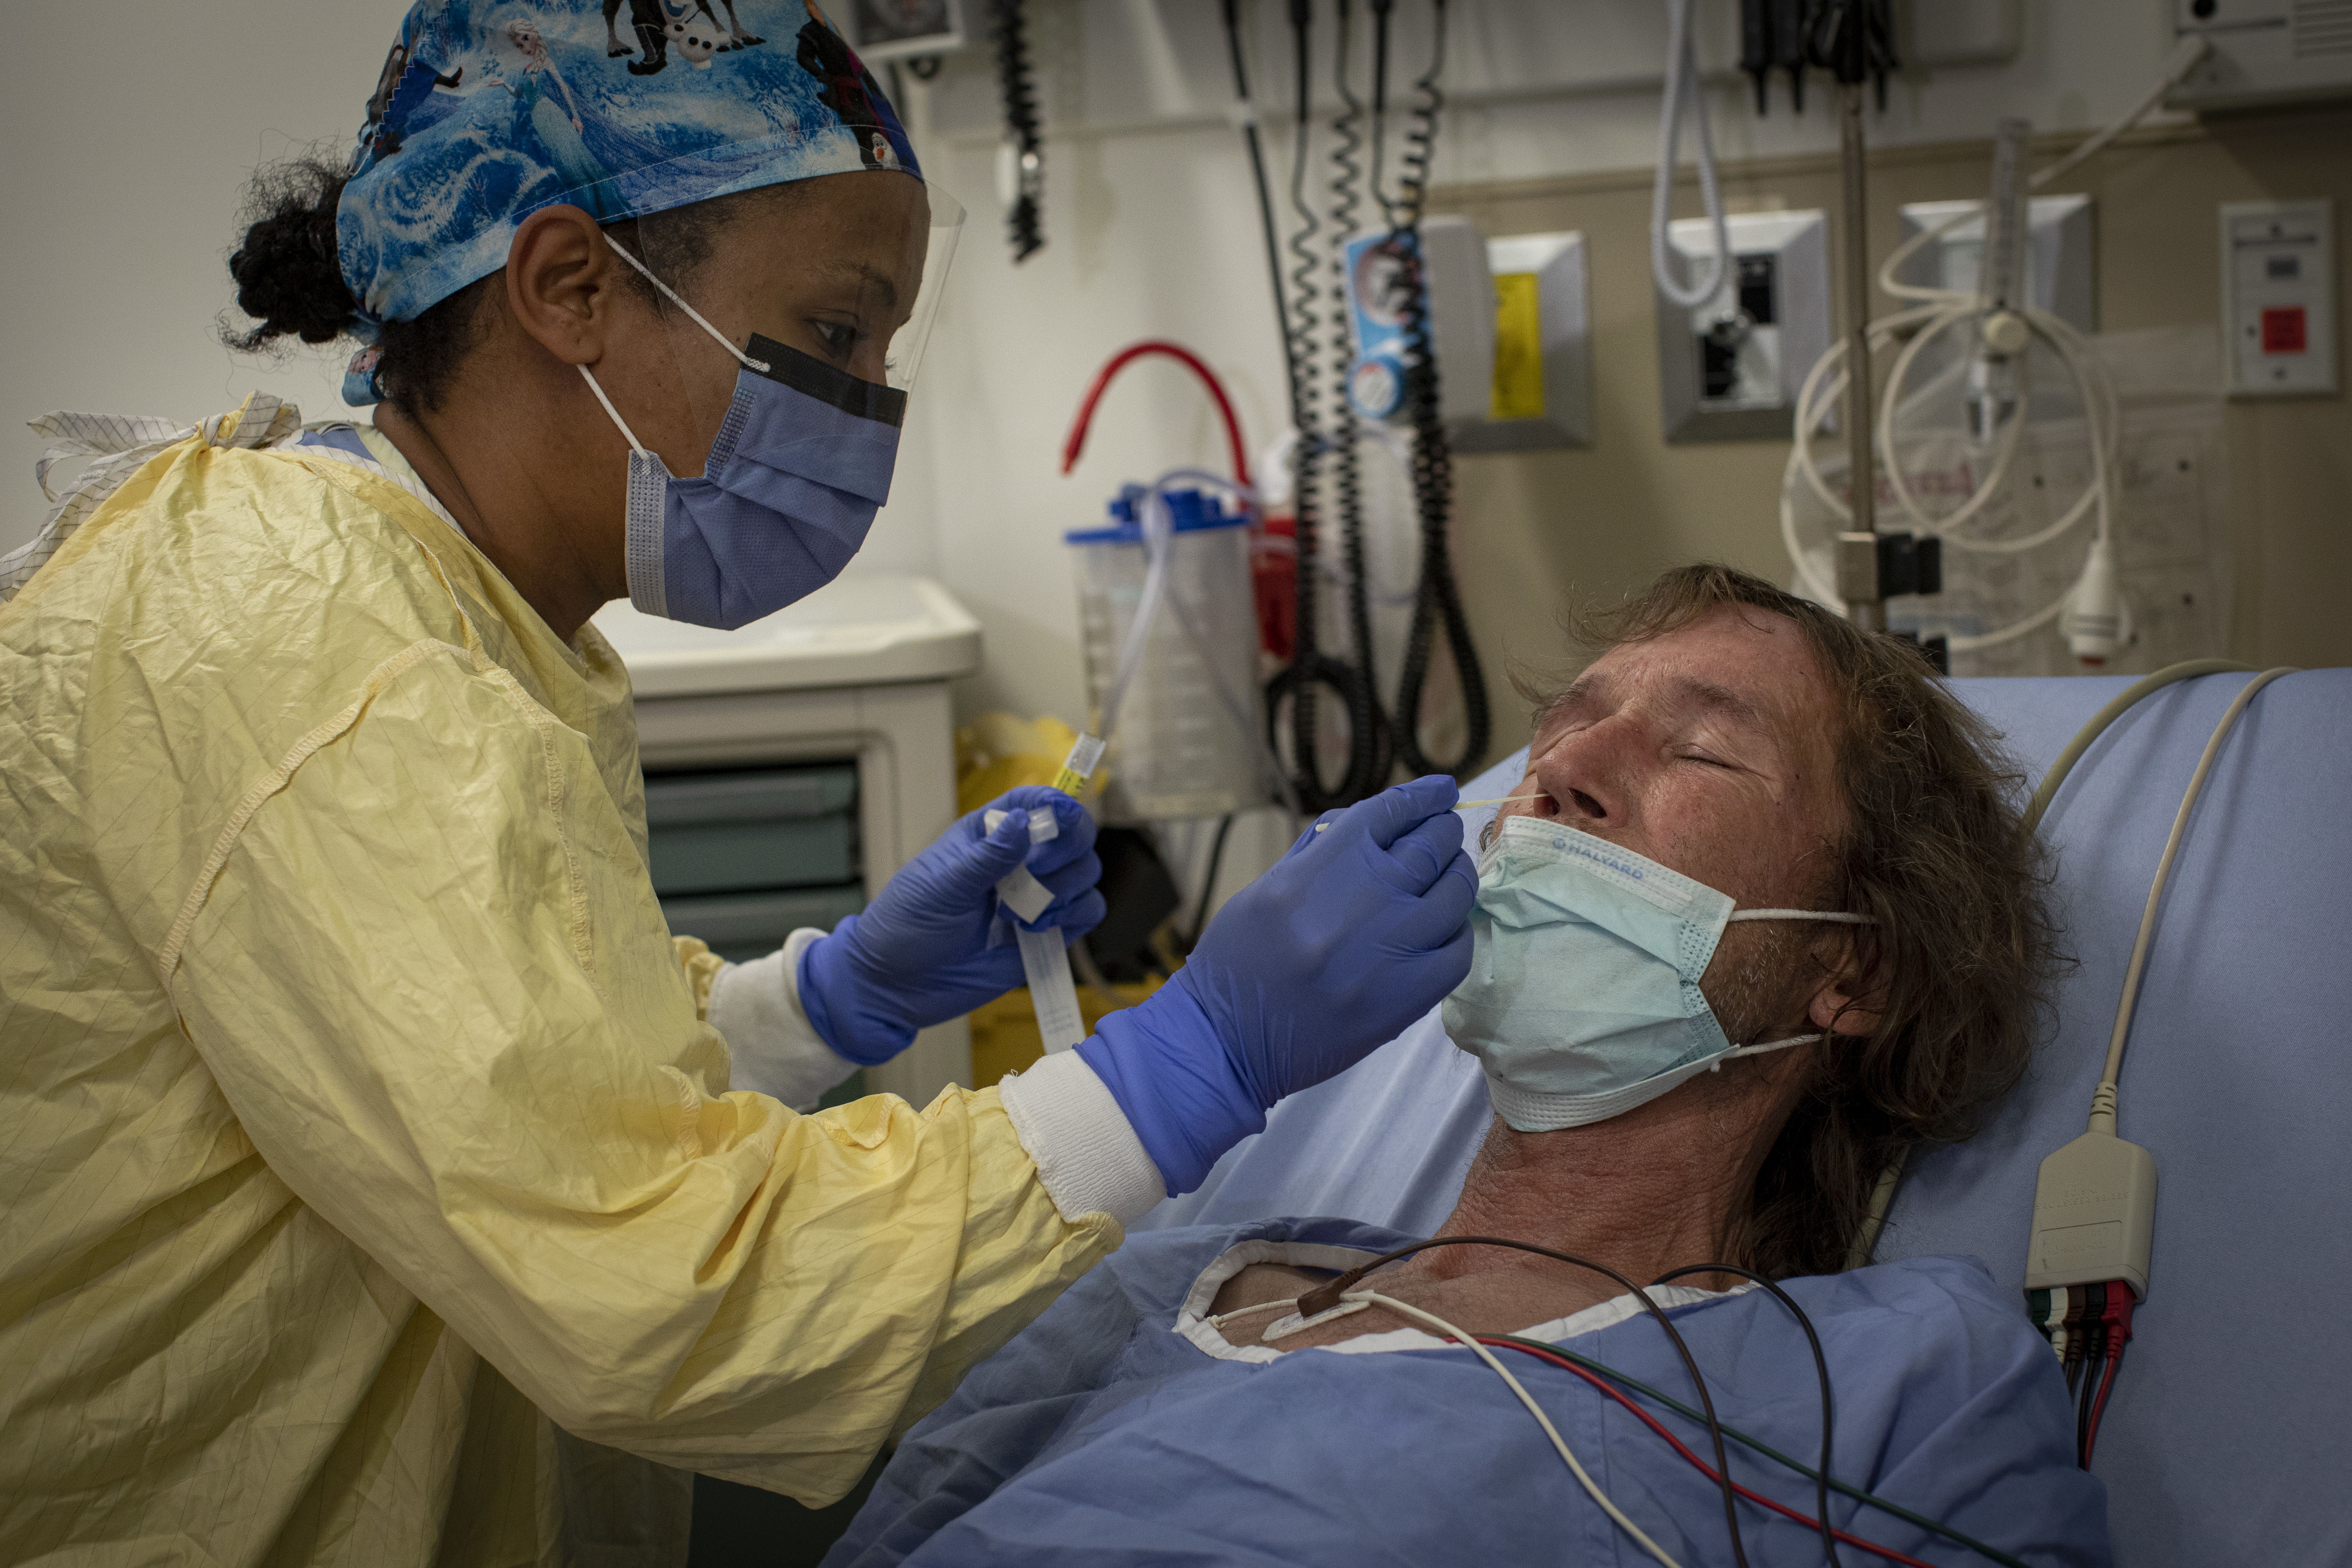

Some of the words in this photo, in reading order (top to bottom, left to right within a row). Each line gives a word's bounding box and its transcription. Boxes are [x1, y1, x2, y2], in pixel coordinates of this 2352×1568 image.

[1568, 844, 1643, 880] HALYARD
[2035, 1196, 2091, 1210] RESISTORS
[2096, 1191, 2129, 1202] SERIES
